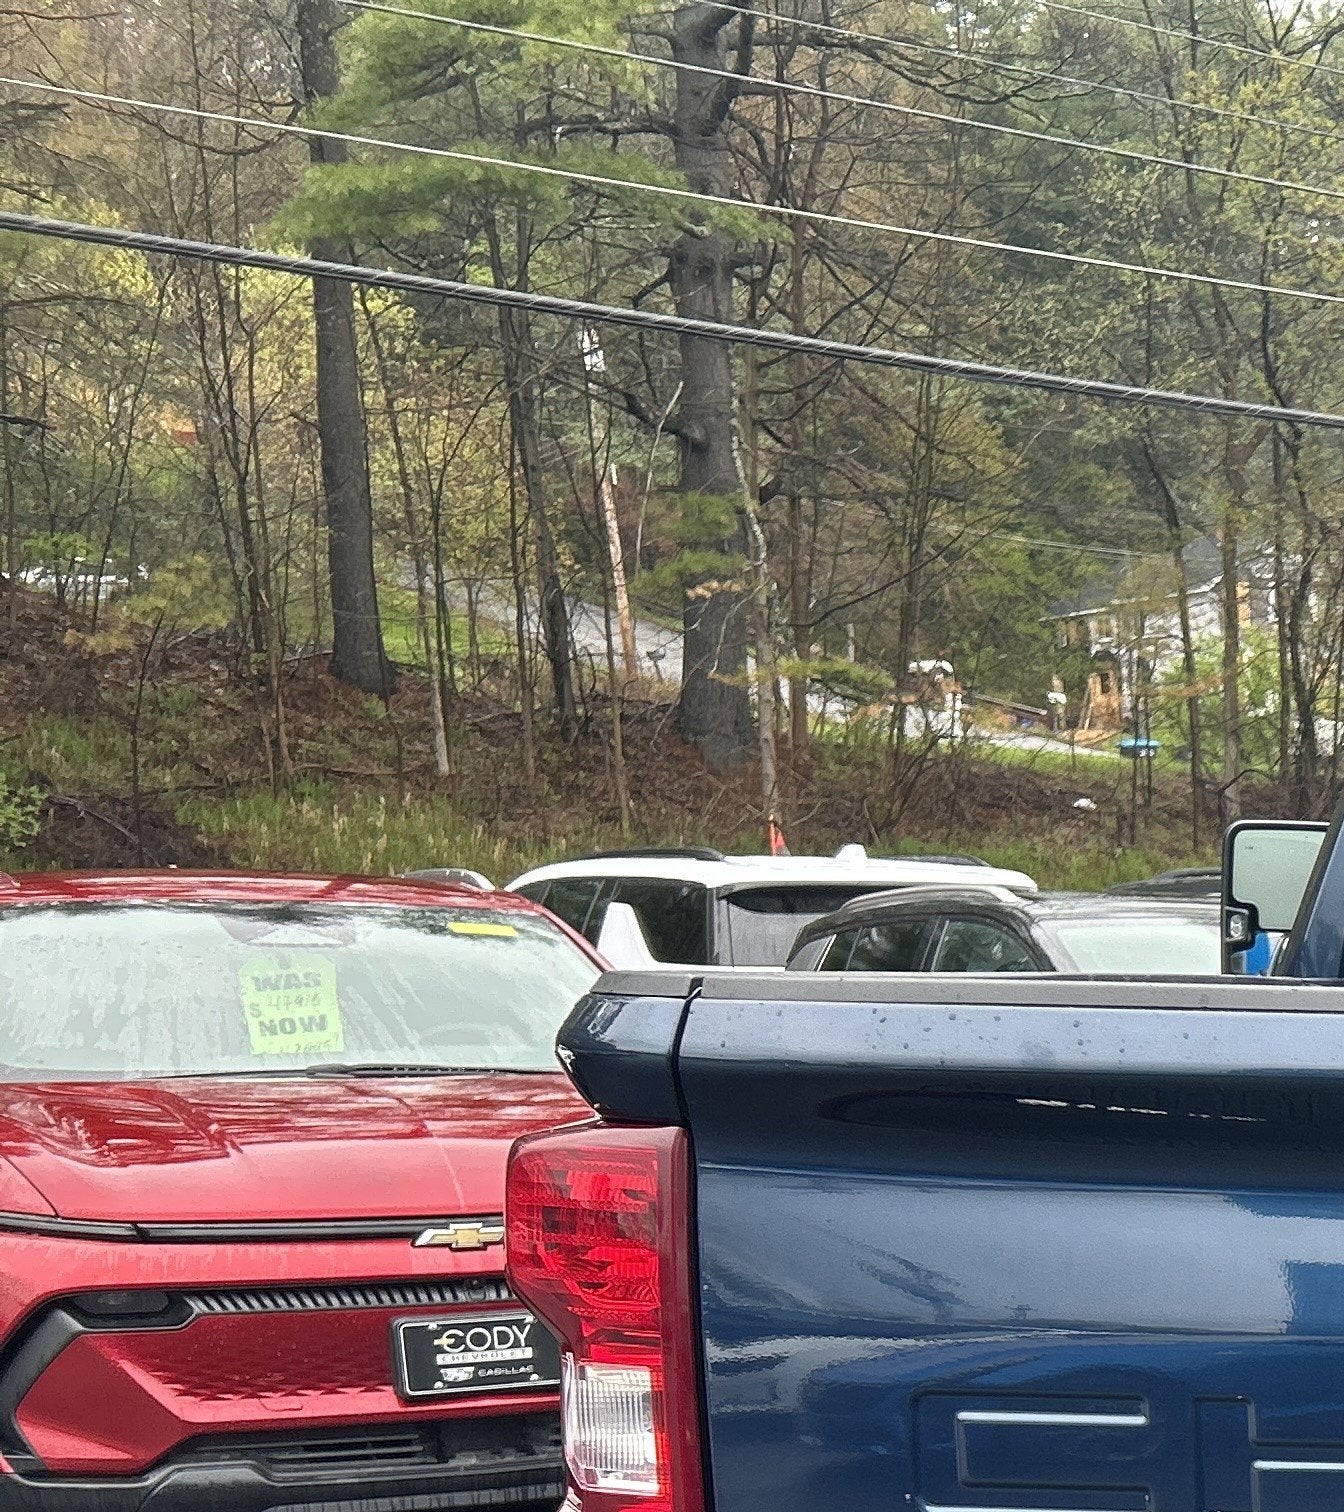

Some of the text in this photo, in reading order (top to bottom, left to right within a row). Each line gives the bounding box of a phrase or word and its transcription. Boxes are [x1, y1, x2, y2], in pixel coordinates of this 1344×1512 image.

[252, 972, 321, 992] WAS
[259, 1014, 328, 1036] NOW
[435, 1325, 531, 1353] CODY
[478, 1365, 534, 1378] CADILLAC
